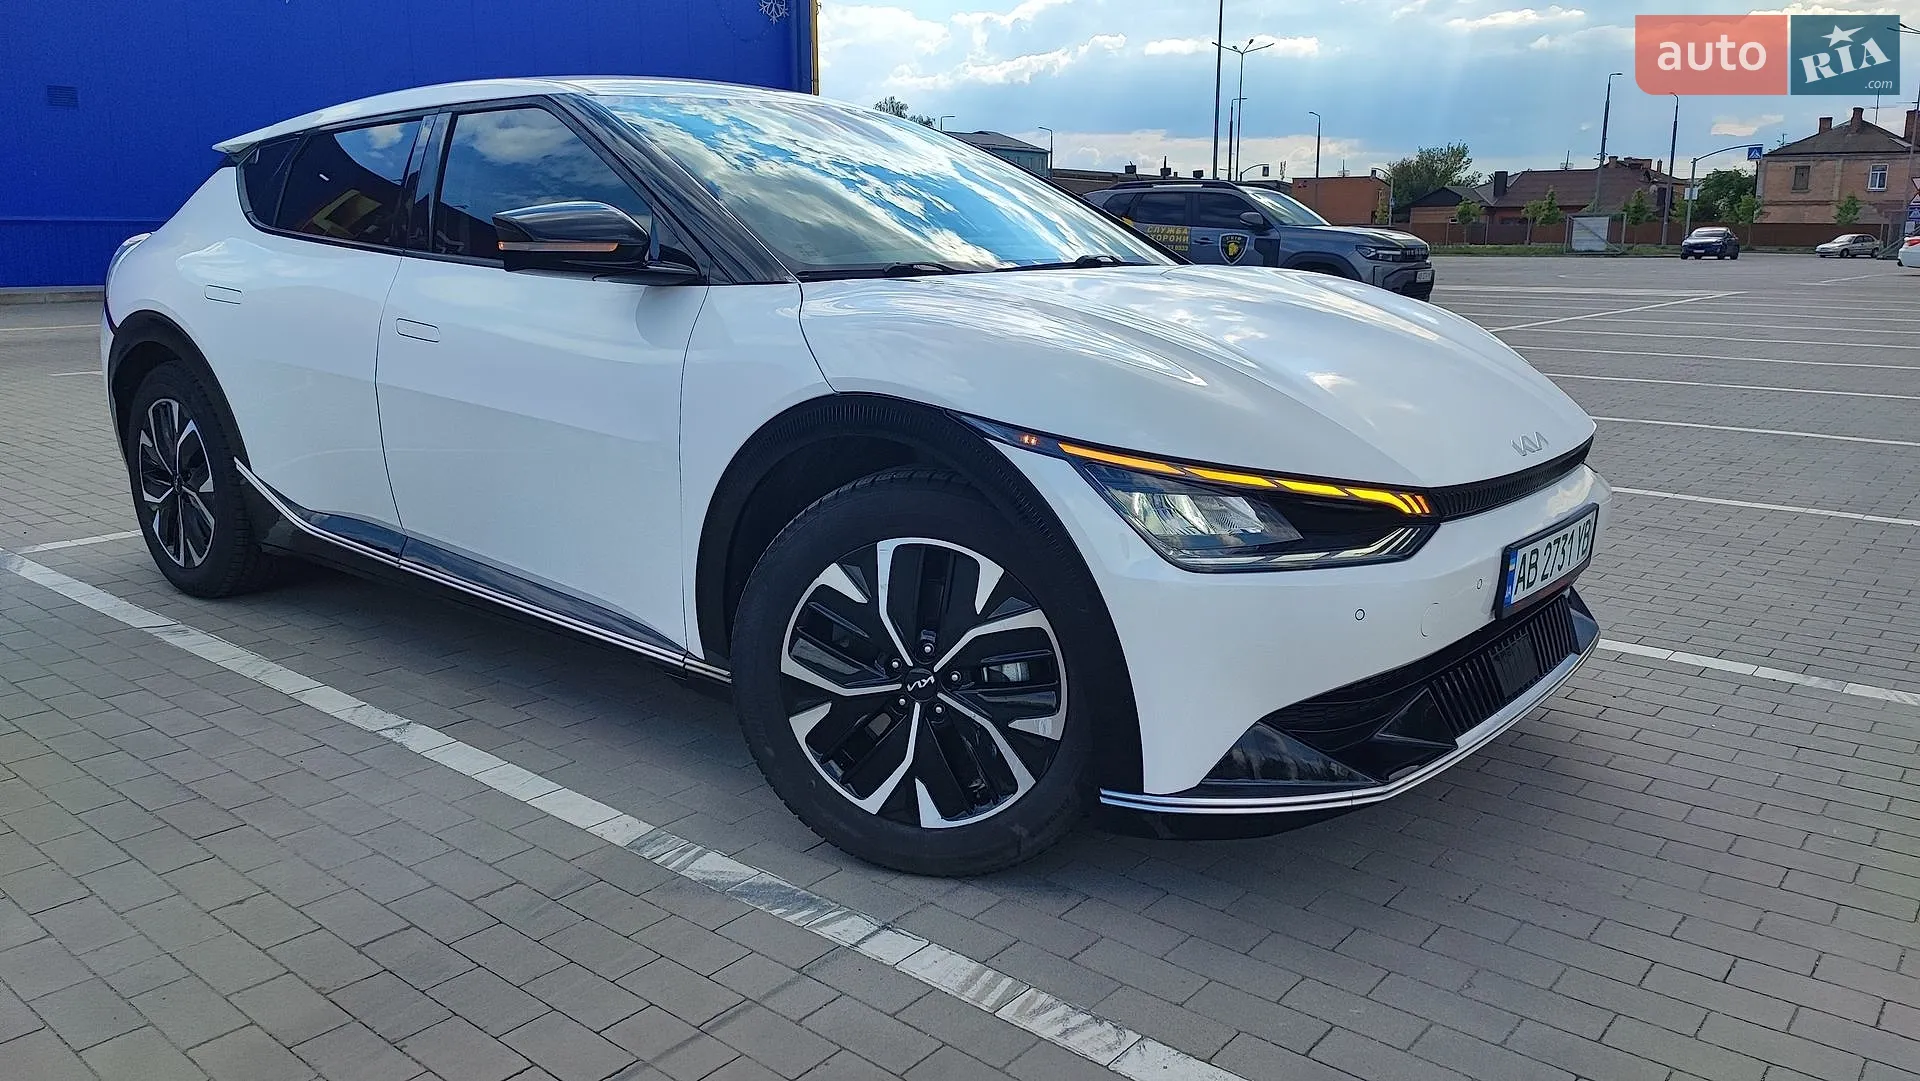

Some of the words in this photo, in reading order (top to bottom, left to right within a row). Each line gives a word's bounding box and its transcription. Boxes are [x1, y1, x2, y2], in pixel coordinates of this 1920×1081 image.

[1147, 226, 1188, 235] СЛУЖБА
[1511, 431, 1549, 457] KIA
[1515, 548, 1540, 594] AB
[1540, 529, 1575, 581] 2731
[1577, 520, 1592, 560] YB
